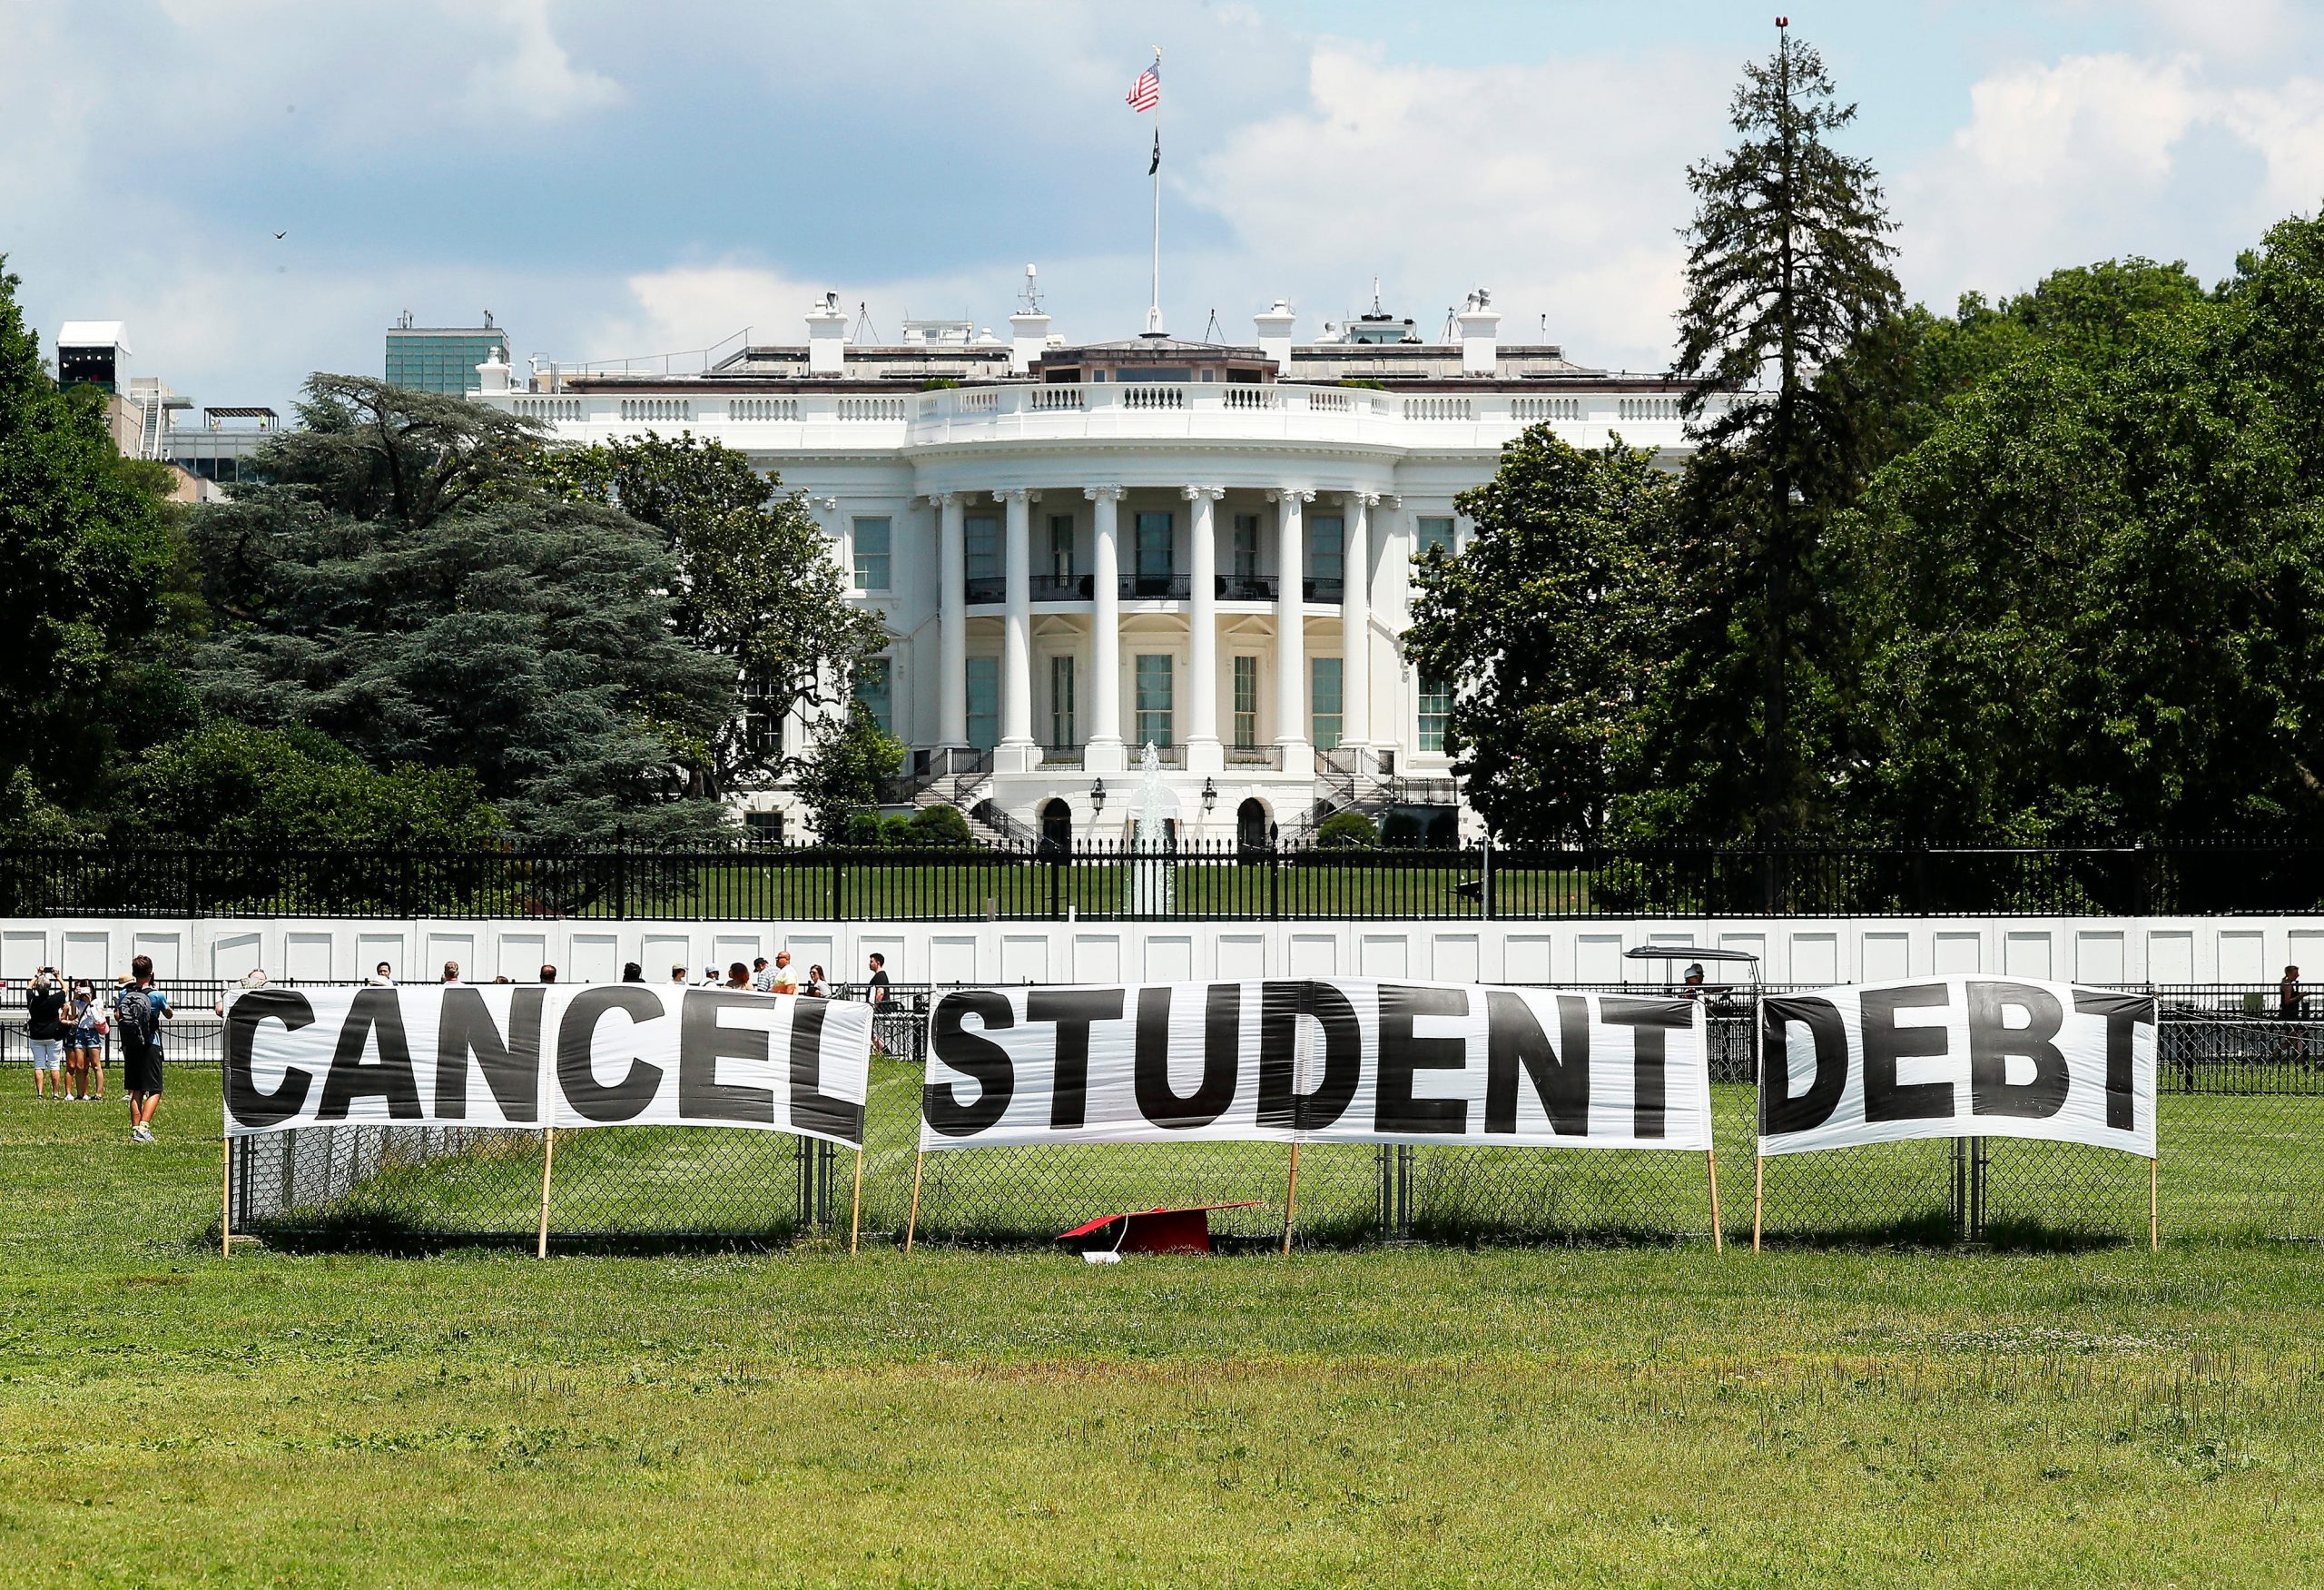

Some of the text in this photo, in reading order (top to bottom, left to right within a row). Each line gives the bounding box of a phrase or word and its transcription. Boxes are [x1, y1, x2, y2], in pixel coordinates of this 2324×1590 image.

[225, 986, 864, 1143] CANCEL
[923, 981, 1693, 1138] STUDENT
[1761, 982, 2154, 1136] DEBT
